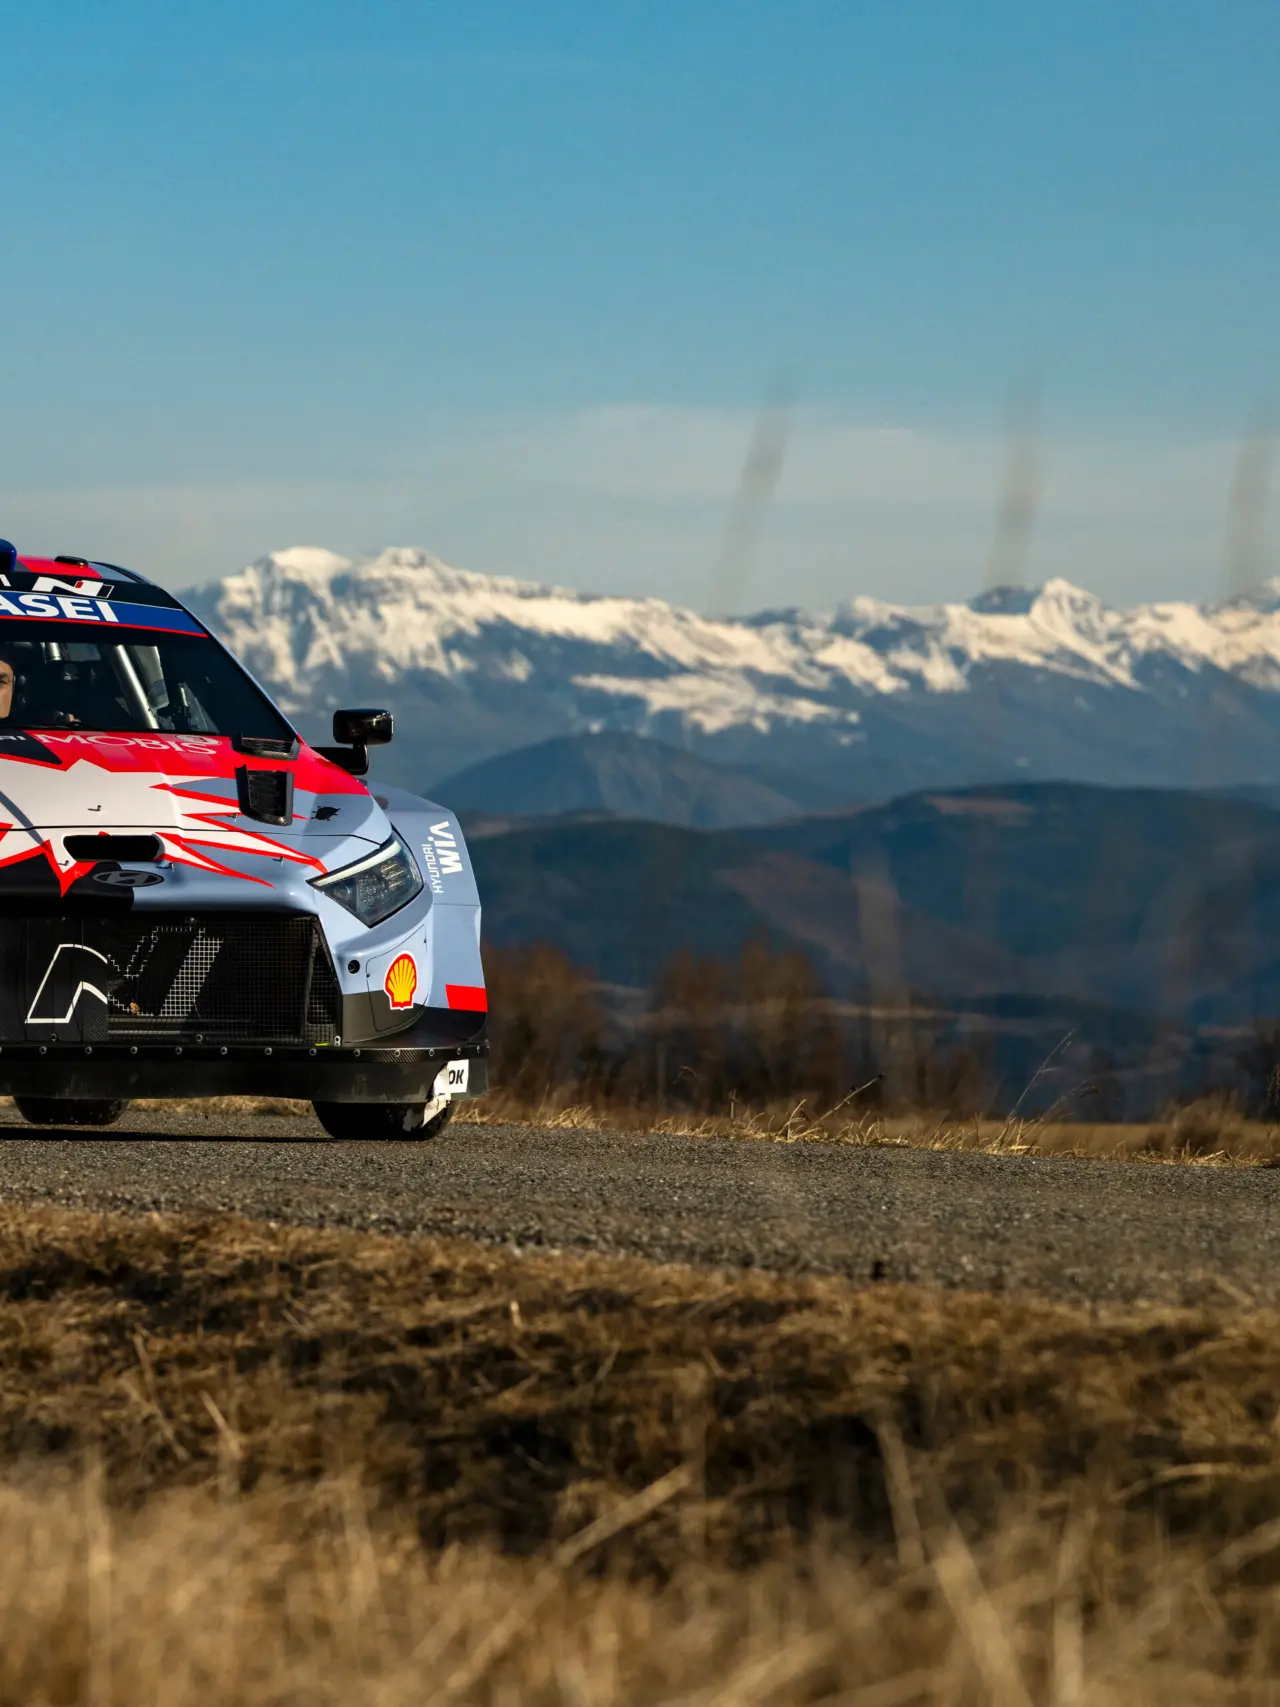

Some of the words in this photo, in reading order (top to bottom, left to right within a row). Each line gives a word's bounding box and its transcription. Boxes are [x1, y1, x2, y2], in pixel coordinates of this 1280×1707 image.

[35, 733, 217, 755] MOBIS
[421, 843, 444, 893] HYUNDAI
[428, 821, 463, 875] WIA
